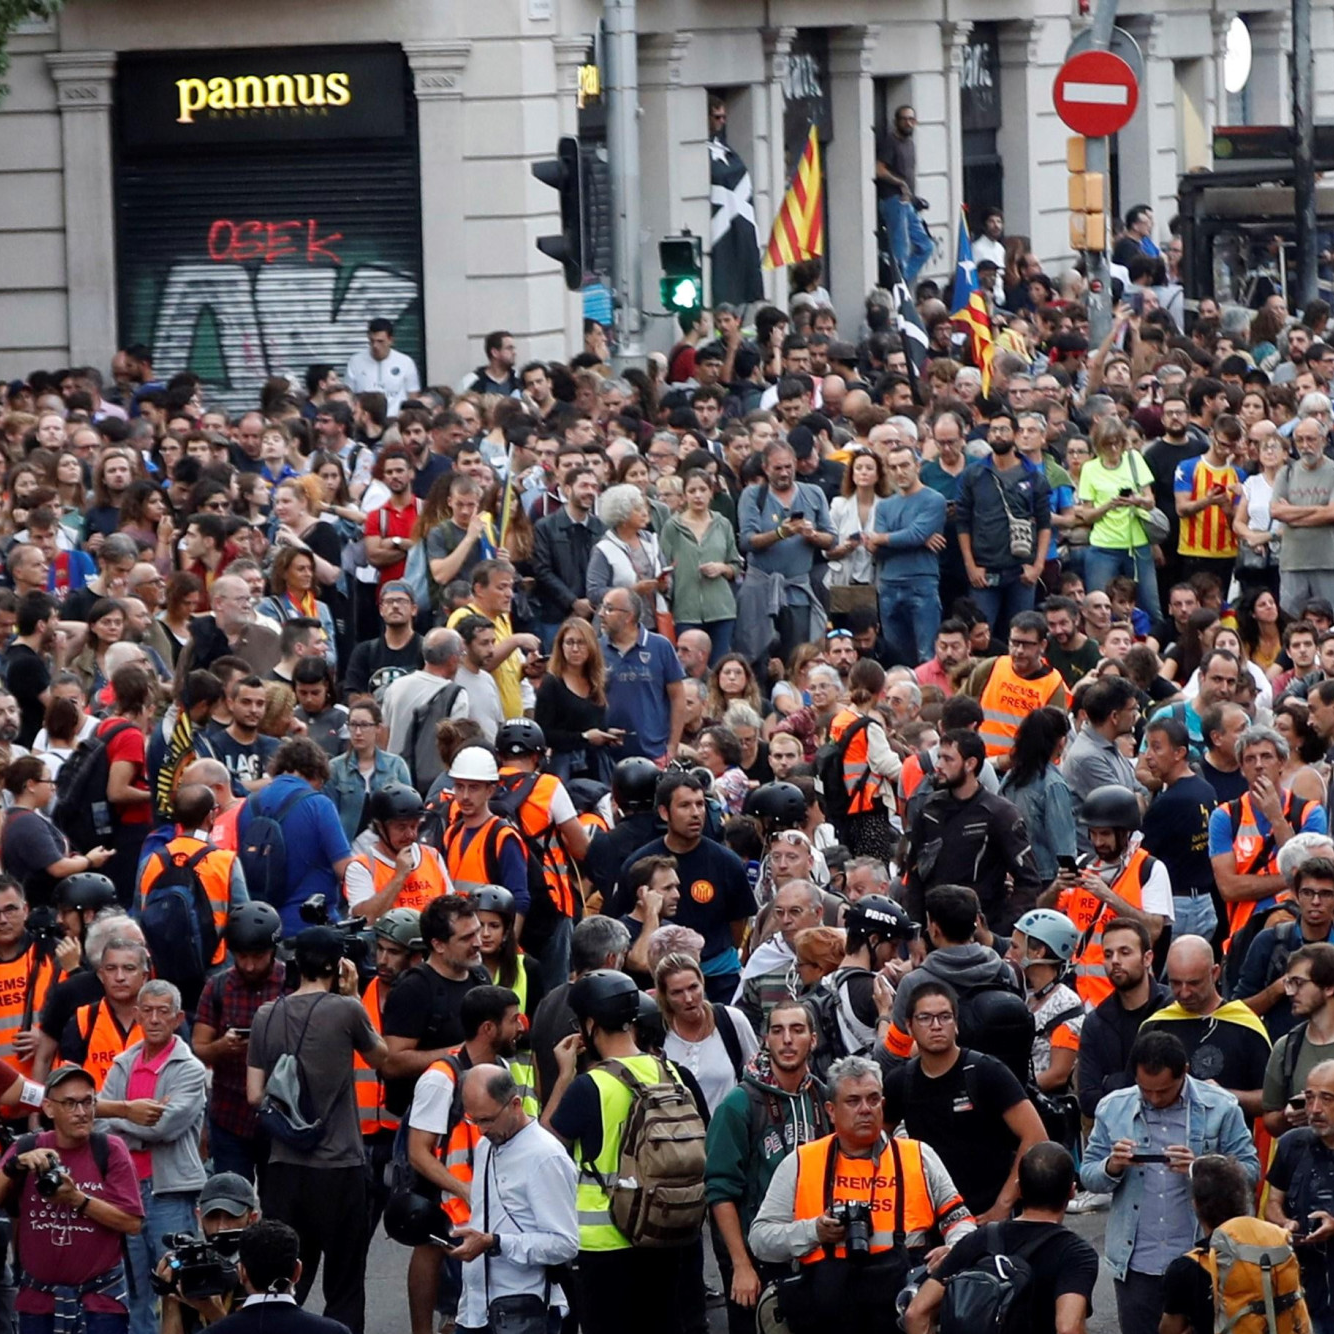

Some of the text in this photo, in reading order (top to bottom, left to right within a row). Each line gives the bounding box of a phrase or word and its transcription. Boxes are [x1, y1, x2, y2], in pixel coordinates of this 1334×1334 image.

[175, 70, 351, 124] pannus
[865, 908, 898, 926] PRESS
[835, 1175, 899, 1191] REMSA
